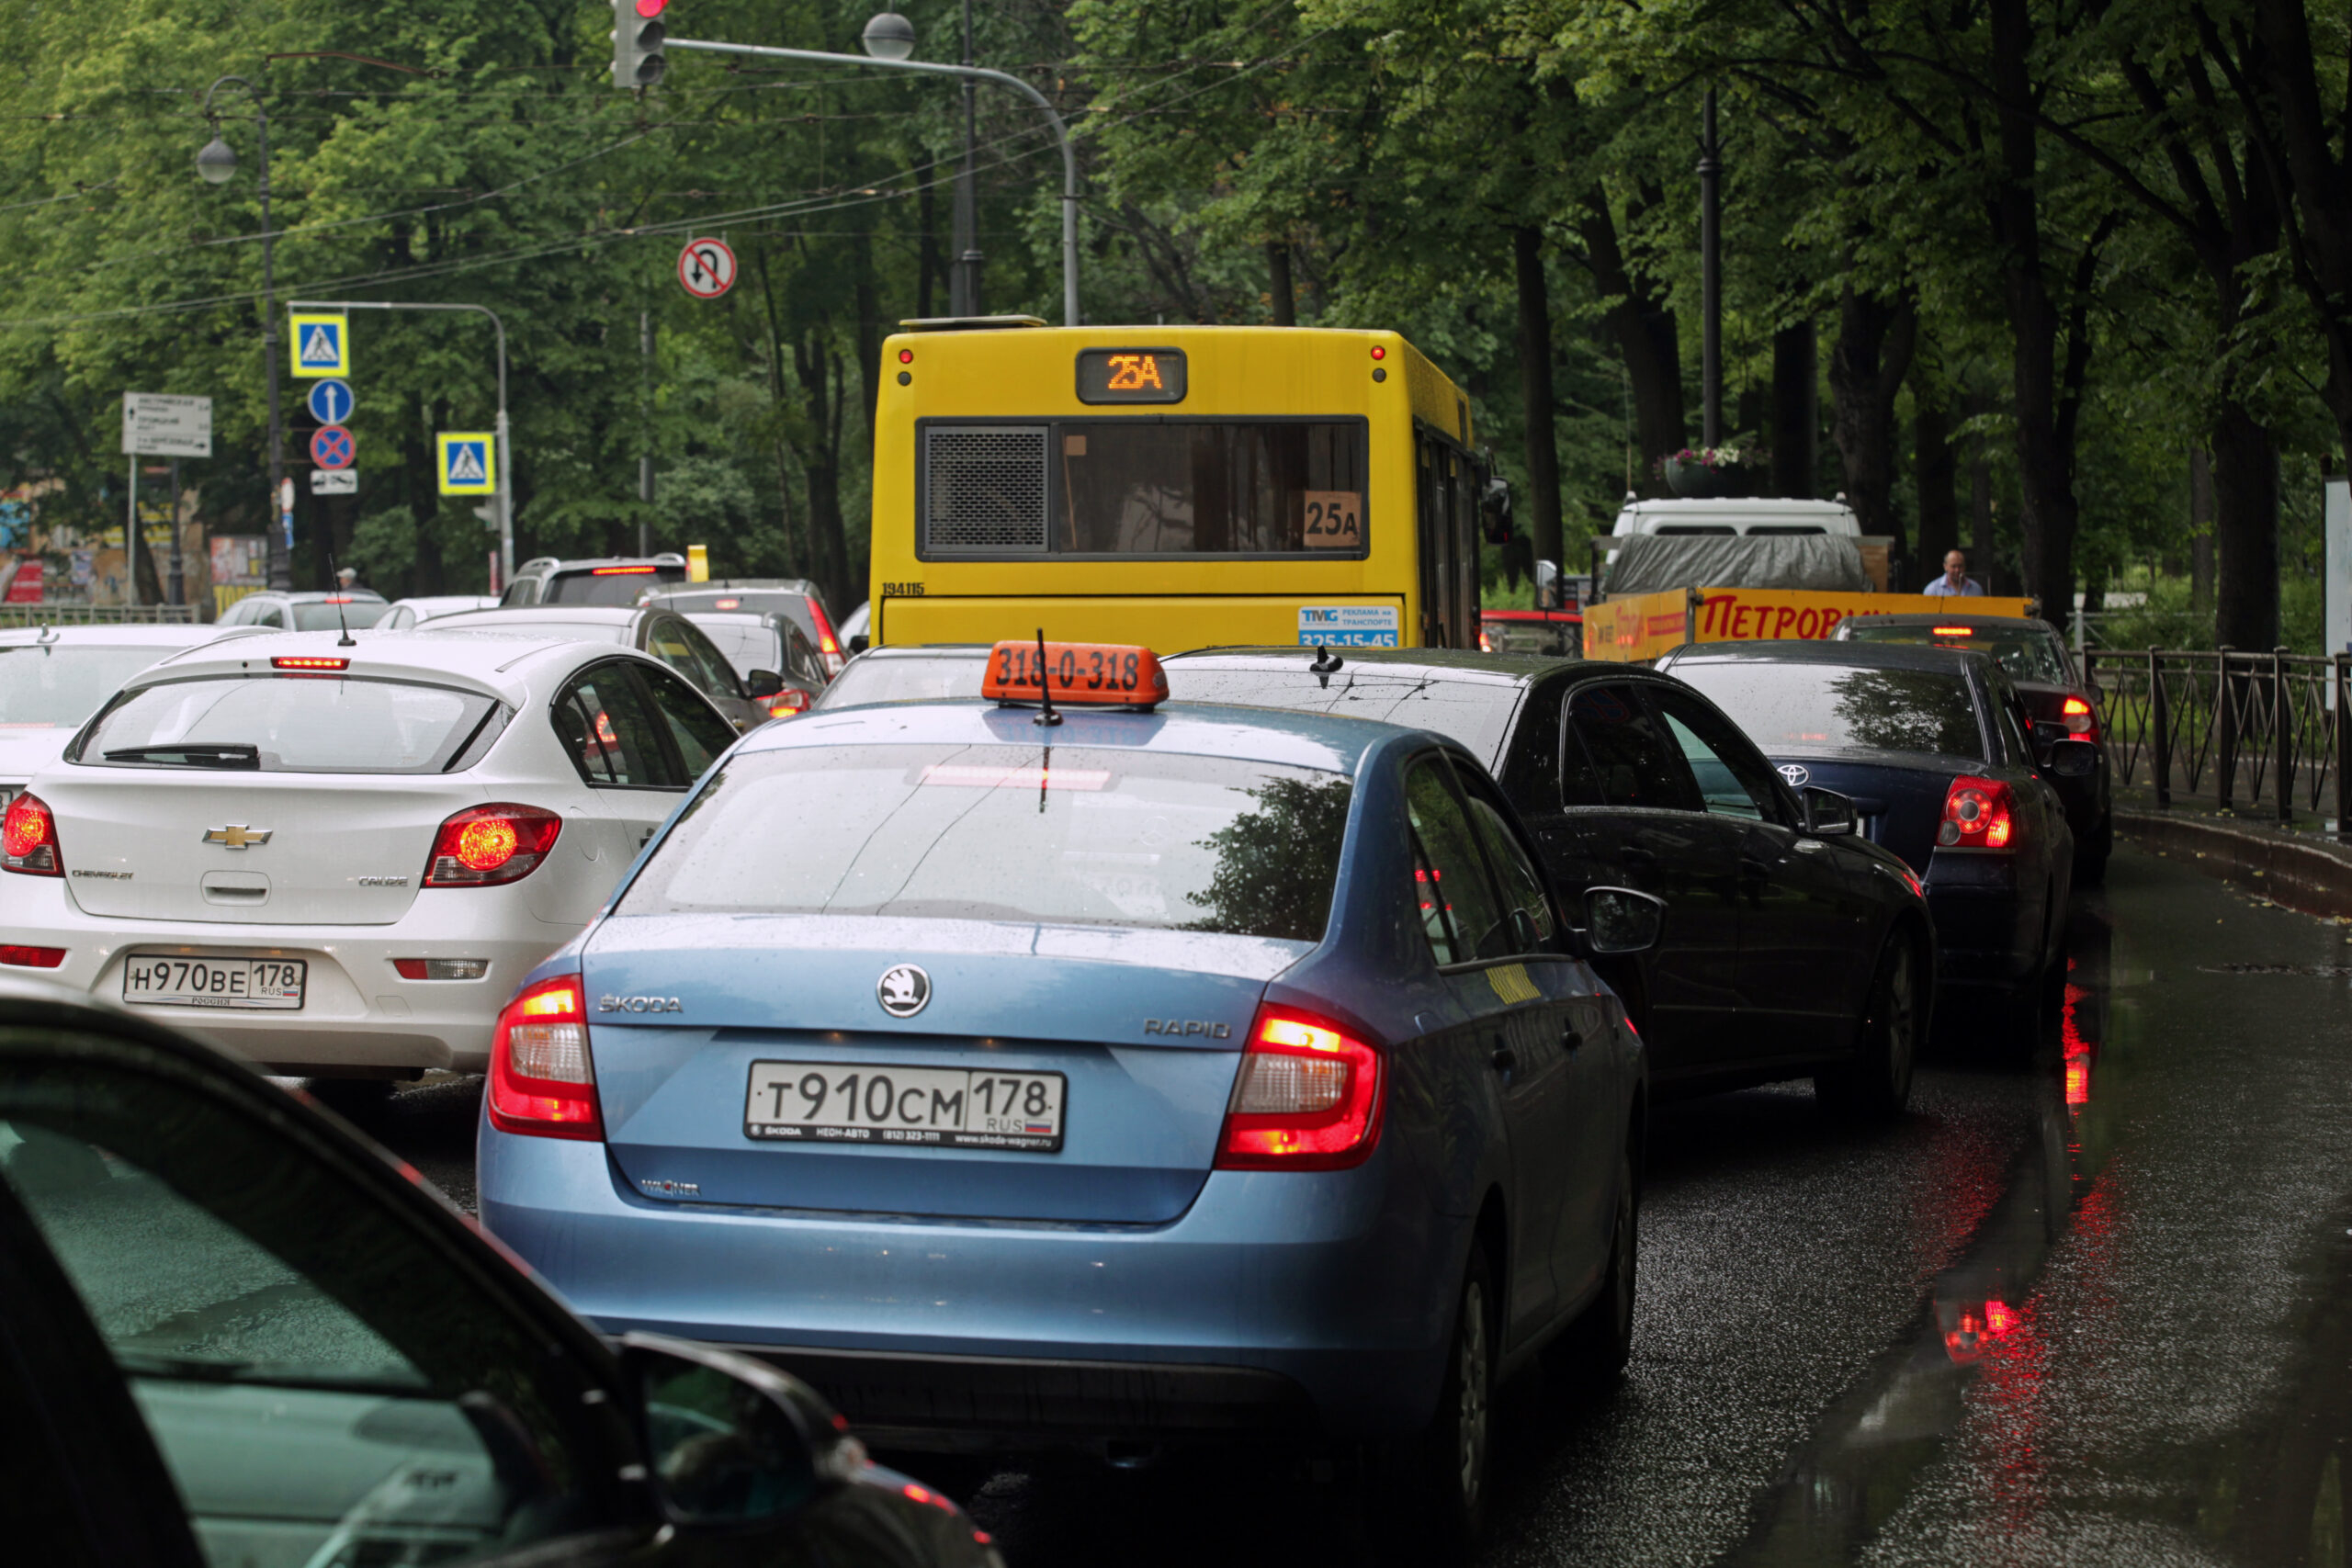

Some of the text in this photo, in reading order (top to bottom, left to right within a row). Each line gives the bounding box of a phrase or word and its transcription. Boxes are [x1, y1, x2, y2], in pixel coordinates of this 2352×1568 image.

[1306, 502, 1358, 536] 25А
[882, 582, 925, 595] 194115
[1302, 610, 1338, 622] TMG
[1703, 595, 1892, 640] ПЕТРОВ
[358, 876, 408, 887] CRUZE
[261, 987, 282, 996] RUS
[1144, 1019, 1232, 1039] RAPID
[974, 1077, 1046, 1116] 178
[986, 1118, 1022, 1133] RUS
